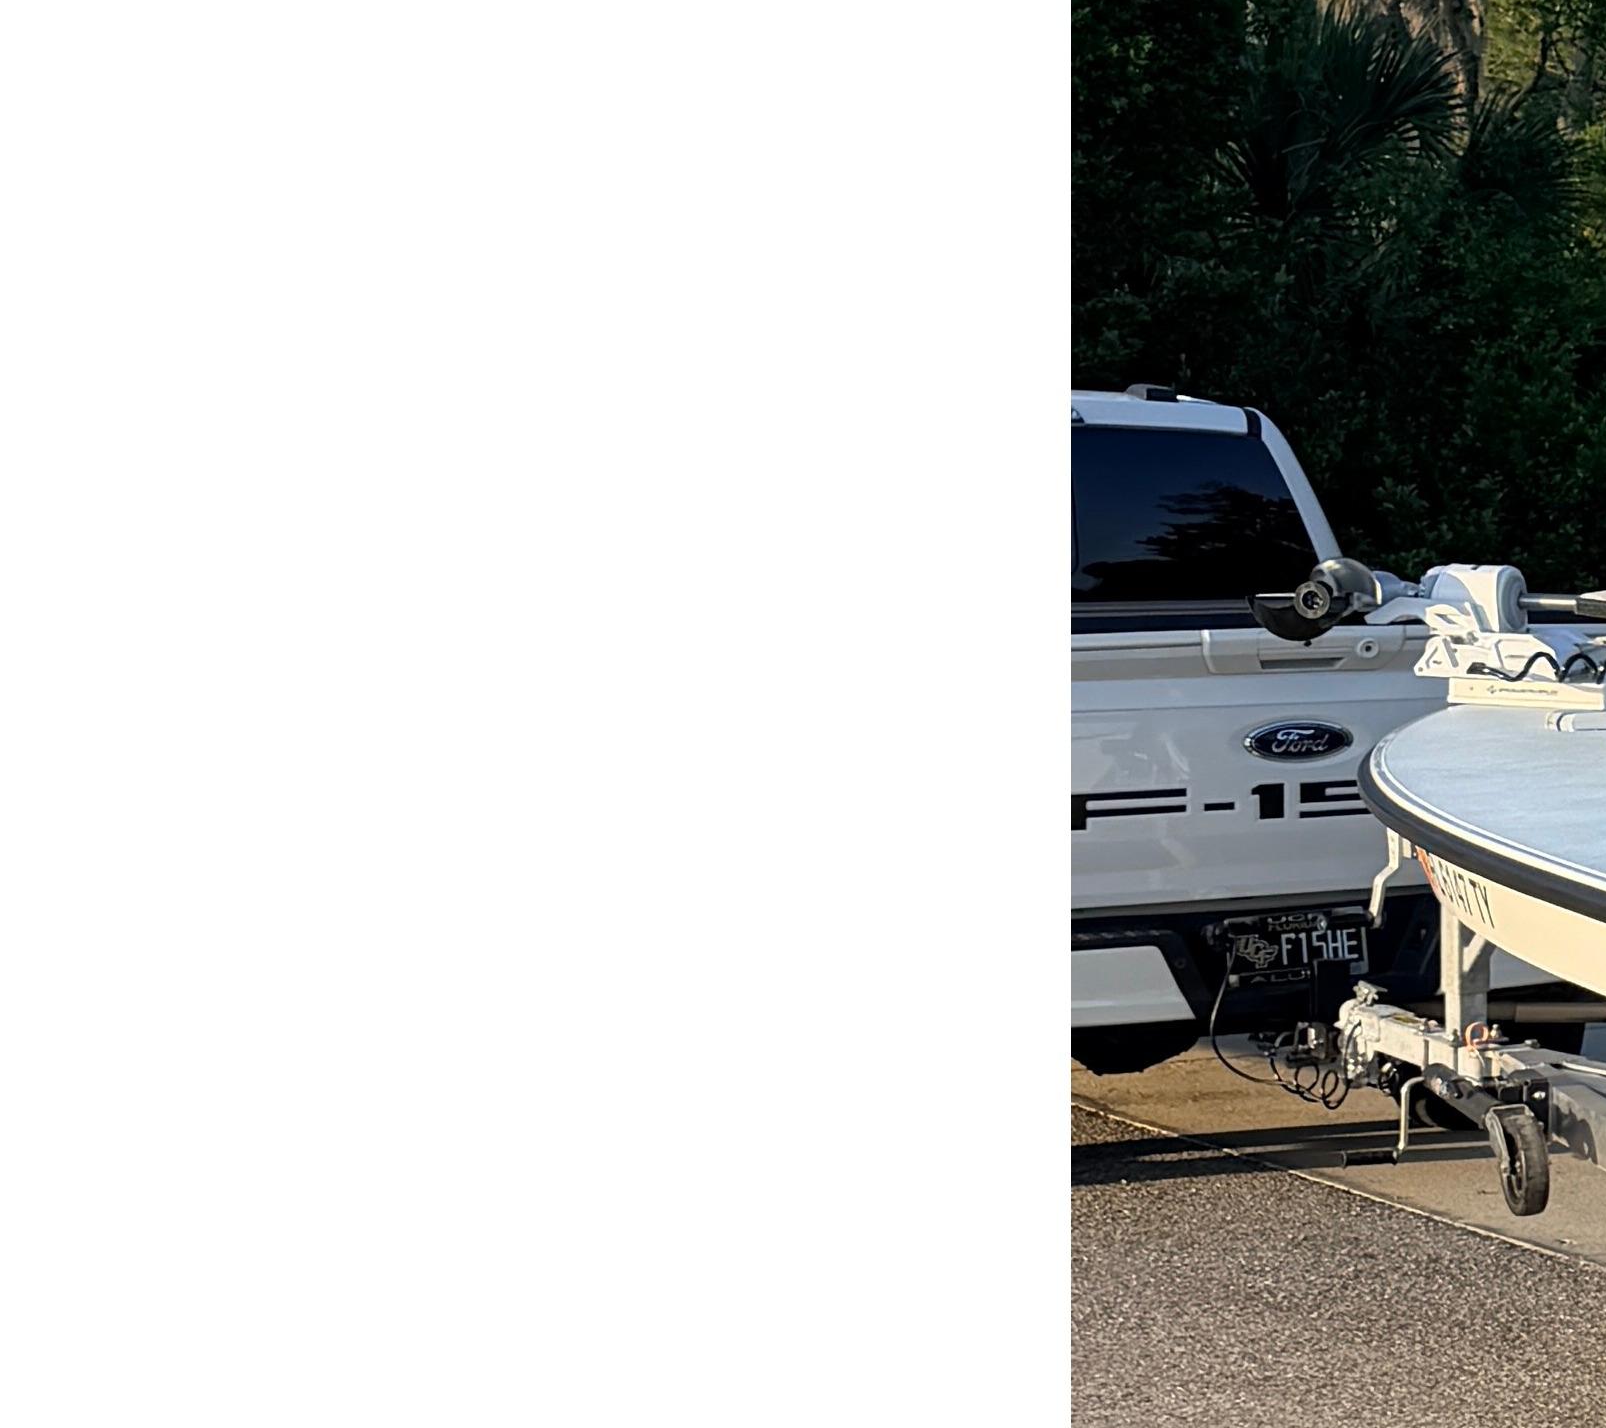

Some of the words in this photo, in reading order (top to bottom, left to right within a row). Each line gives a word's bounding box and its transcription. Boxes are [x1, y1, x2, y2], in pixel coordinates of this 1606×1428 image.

[1270, 728, 1329, 753] Ford
[1071, 779, 1372, 831] F-15
[1468, 877, 1495, 929] TY
